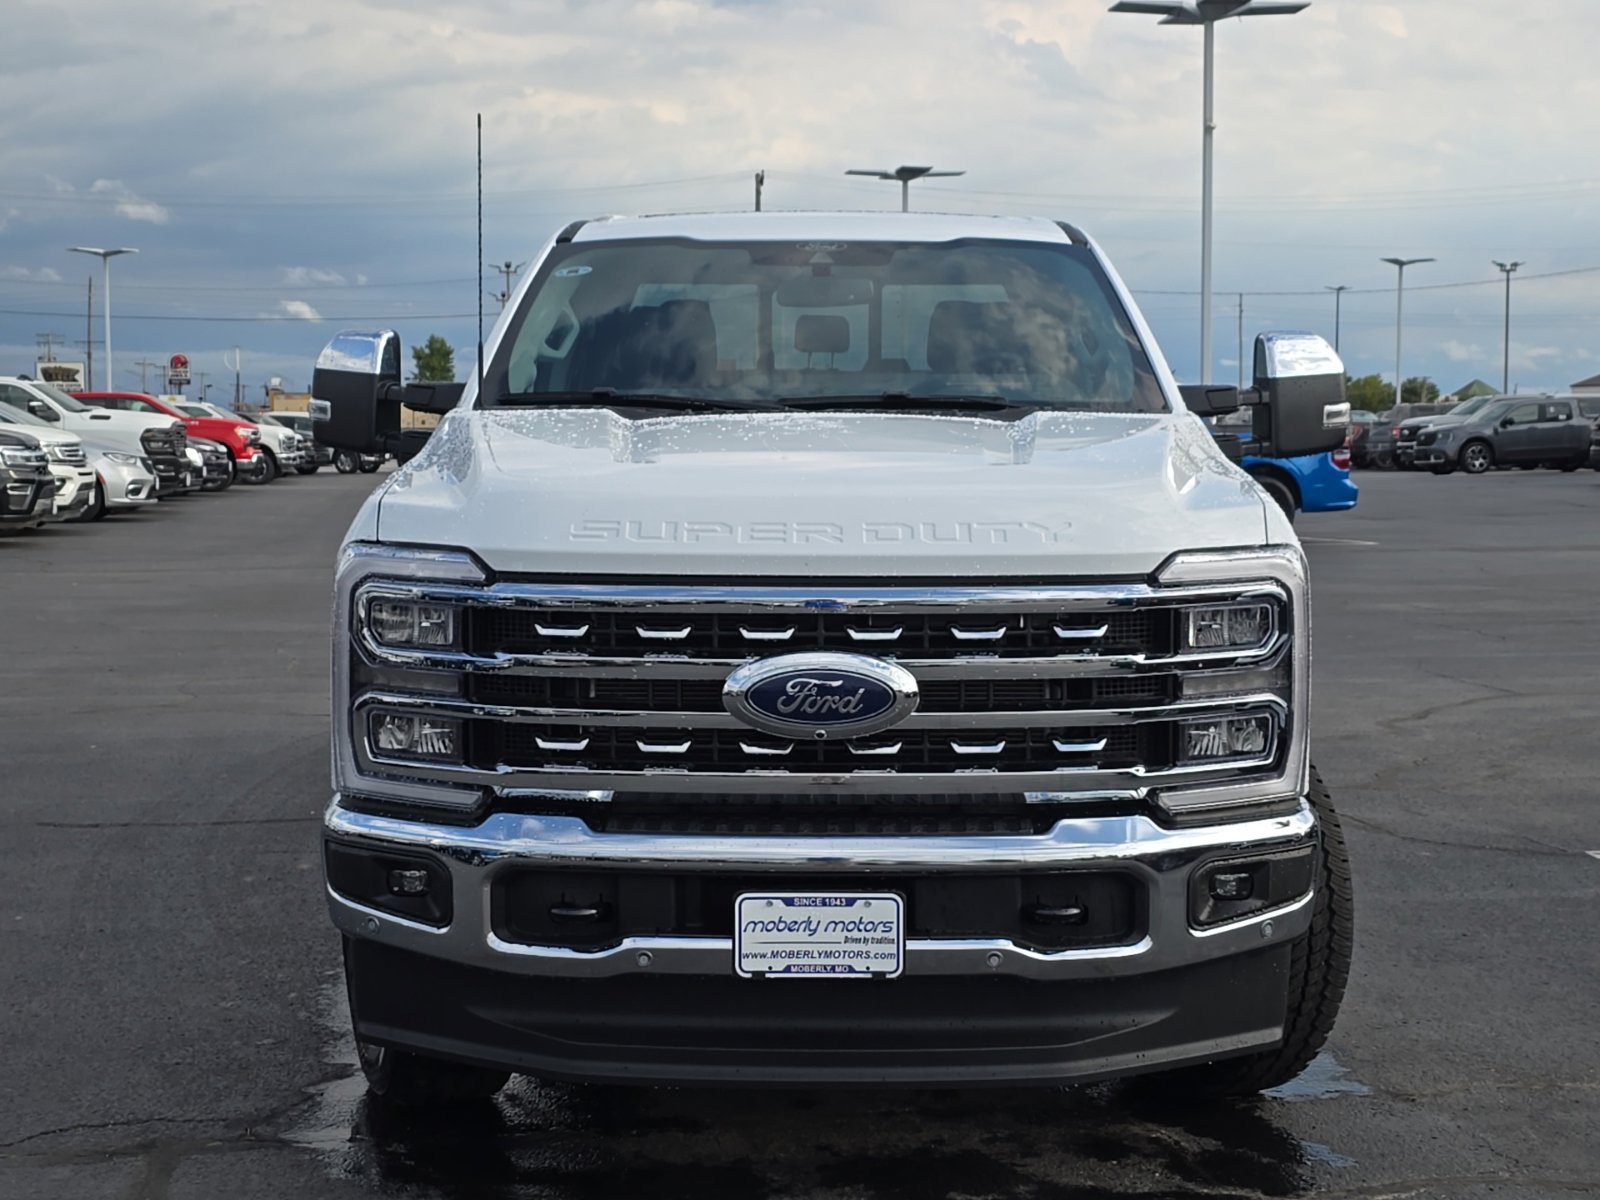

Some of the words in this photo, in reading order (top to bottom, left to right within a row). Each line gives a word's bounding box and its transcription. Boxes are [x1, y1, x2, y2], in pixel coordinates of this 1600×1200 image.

[569, 519, 844, 544] SUPER
[862, 522, 1072, 544] DUTY
[777, 677, 865, 714] Ford
[793, 897, 822, 906] SINCE
[825, 897, 846, 906] 1943
[743, 916, 821, 936] moberly
[824, 916, 894, 933] motors
[863, 936, 869, 946] by
[742, 950, 896, 960] www.MOBERLYMOTORS.com
